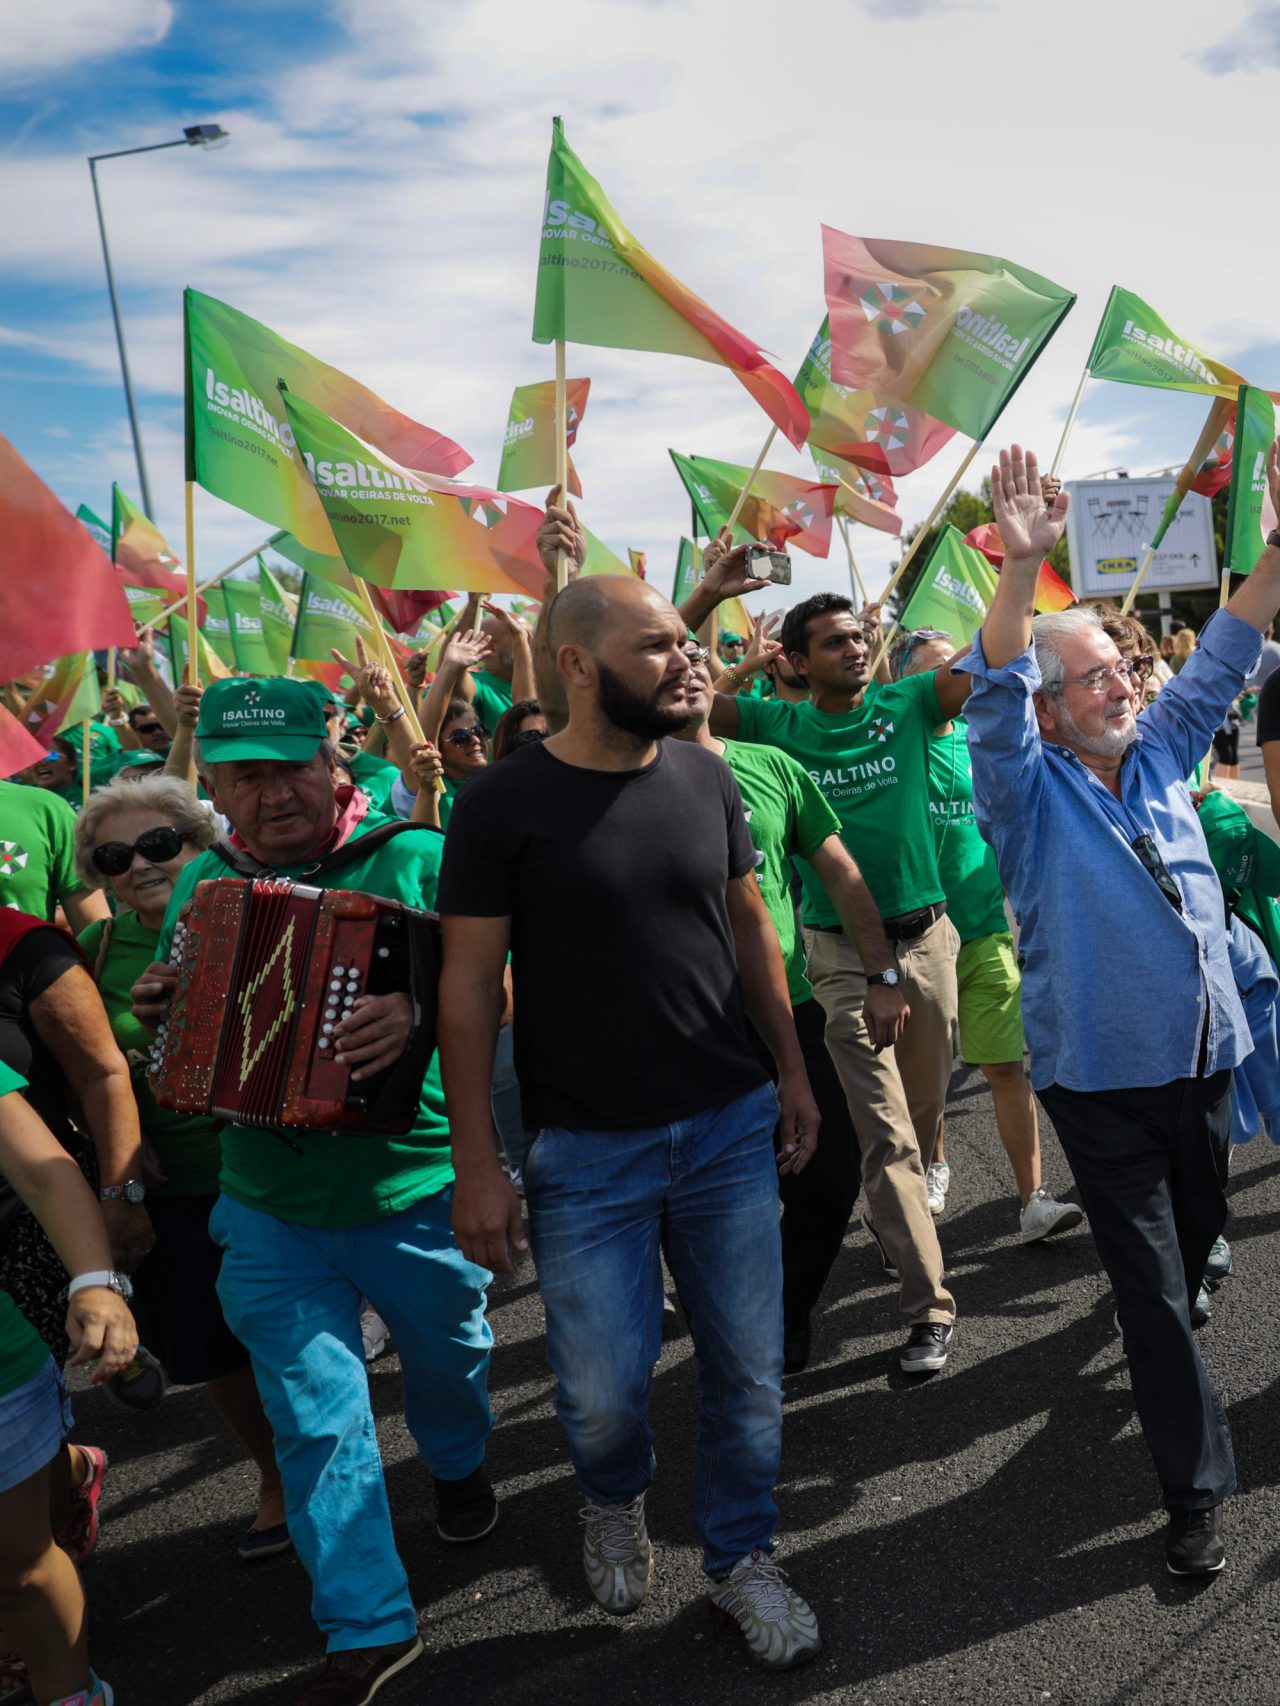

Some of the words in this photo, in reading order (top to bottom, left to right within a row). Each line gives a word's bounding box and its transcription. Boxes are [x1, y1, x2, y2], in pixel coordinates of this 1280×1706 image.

[1122, 334, 1153, 353] INOVAR
[1123, 320, 1219, 385] Isaltino
[206, 368, 297, 448] Isaltino
[351, 489, 391, 500] OEIRAS
[393, 491, 406, 502] DE
[408, 494, 436, 506] VOLTA
[223, 709, 285, 721] ISALTINO
[832, 786, 863, 798] Oeiras
[864, 782, 876, 790] de
[876, 775, 899, 787] Volta
